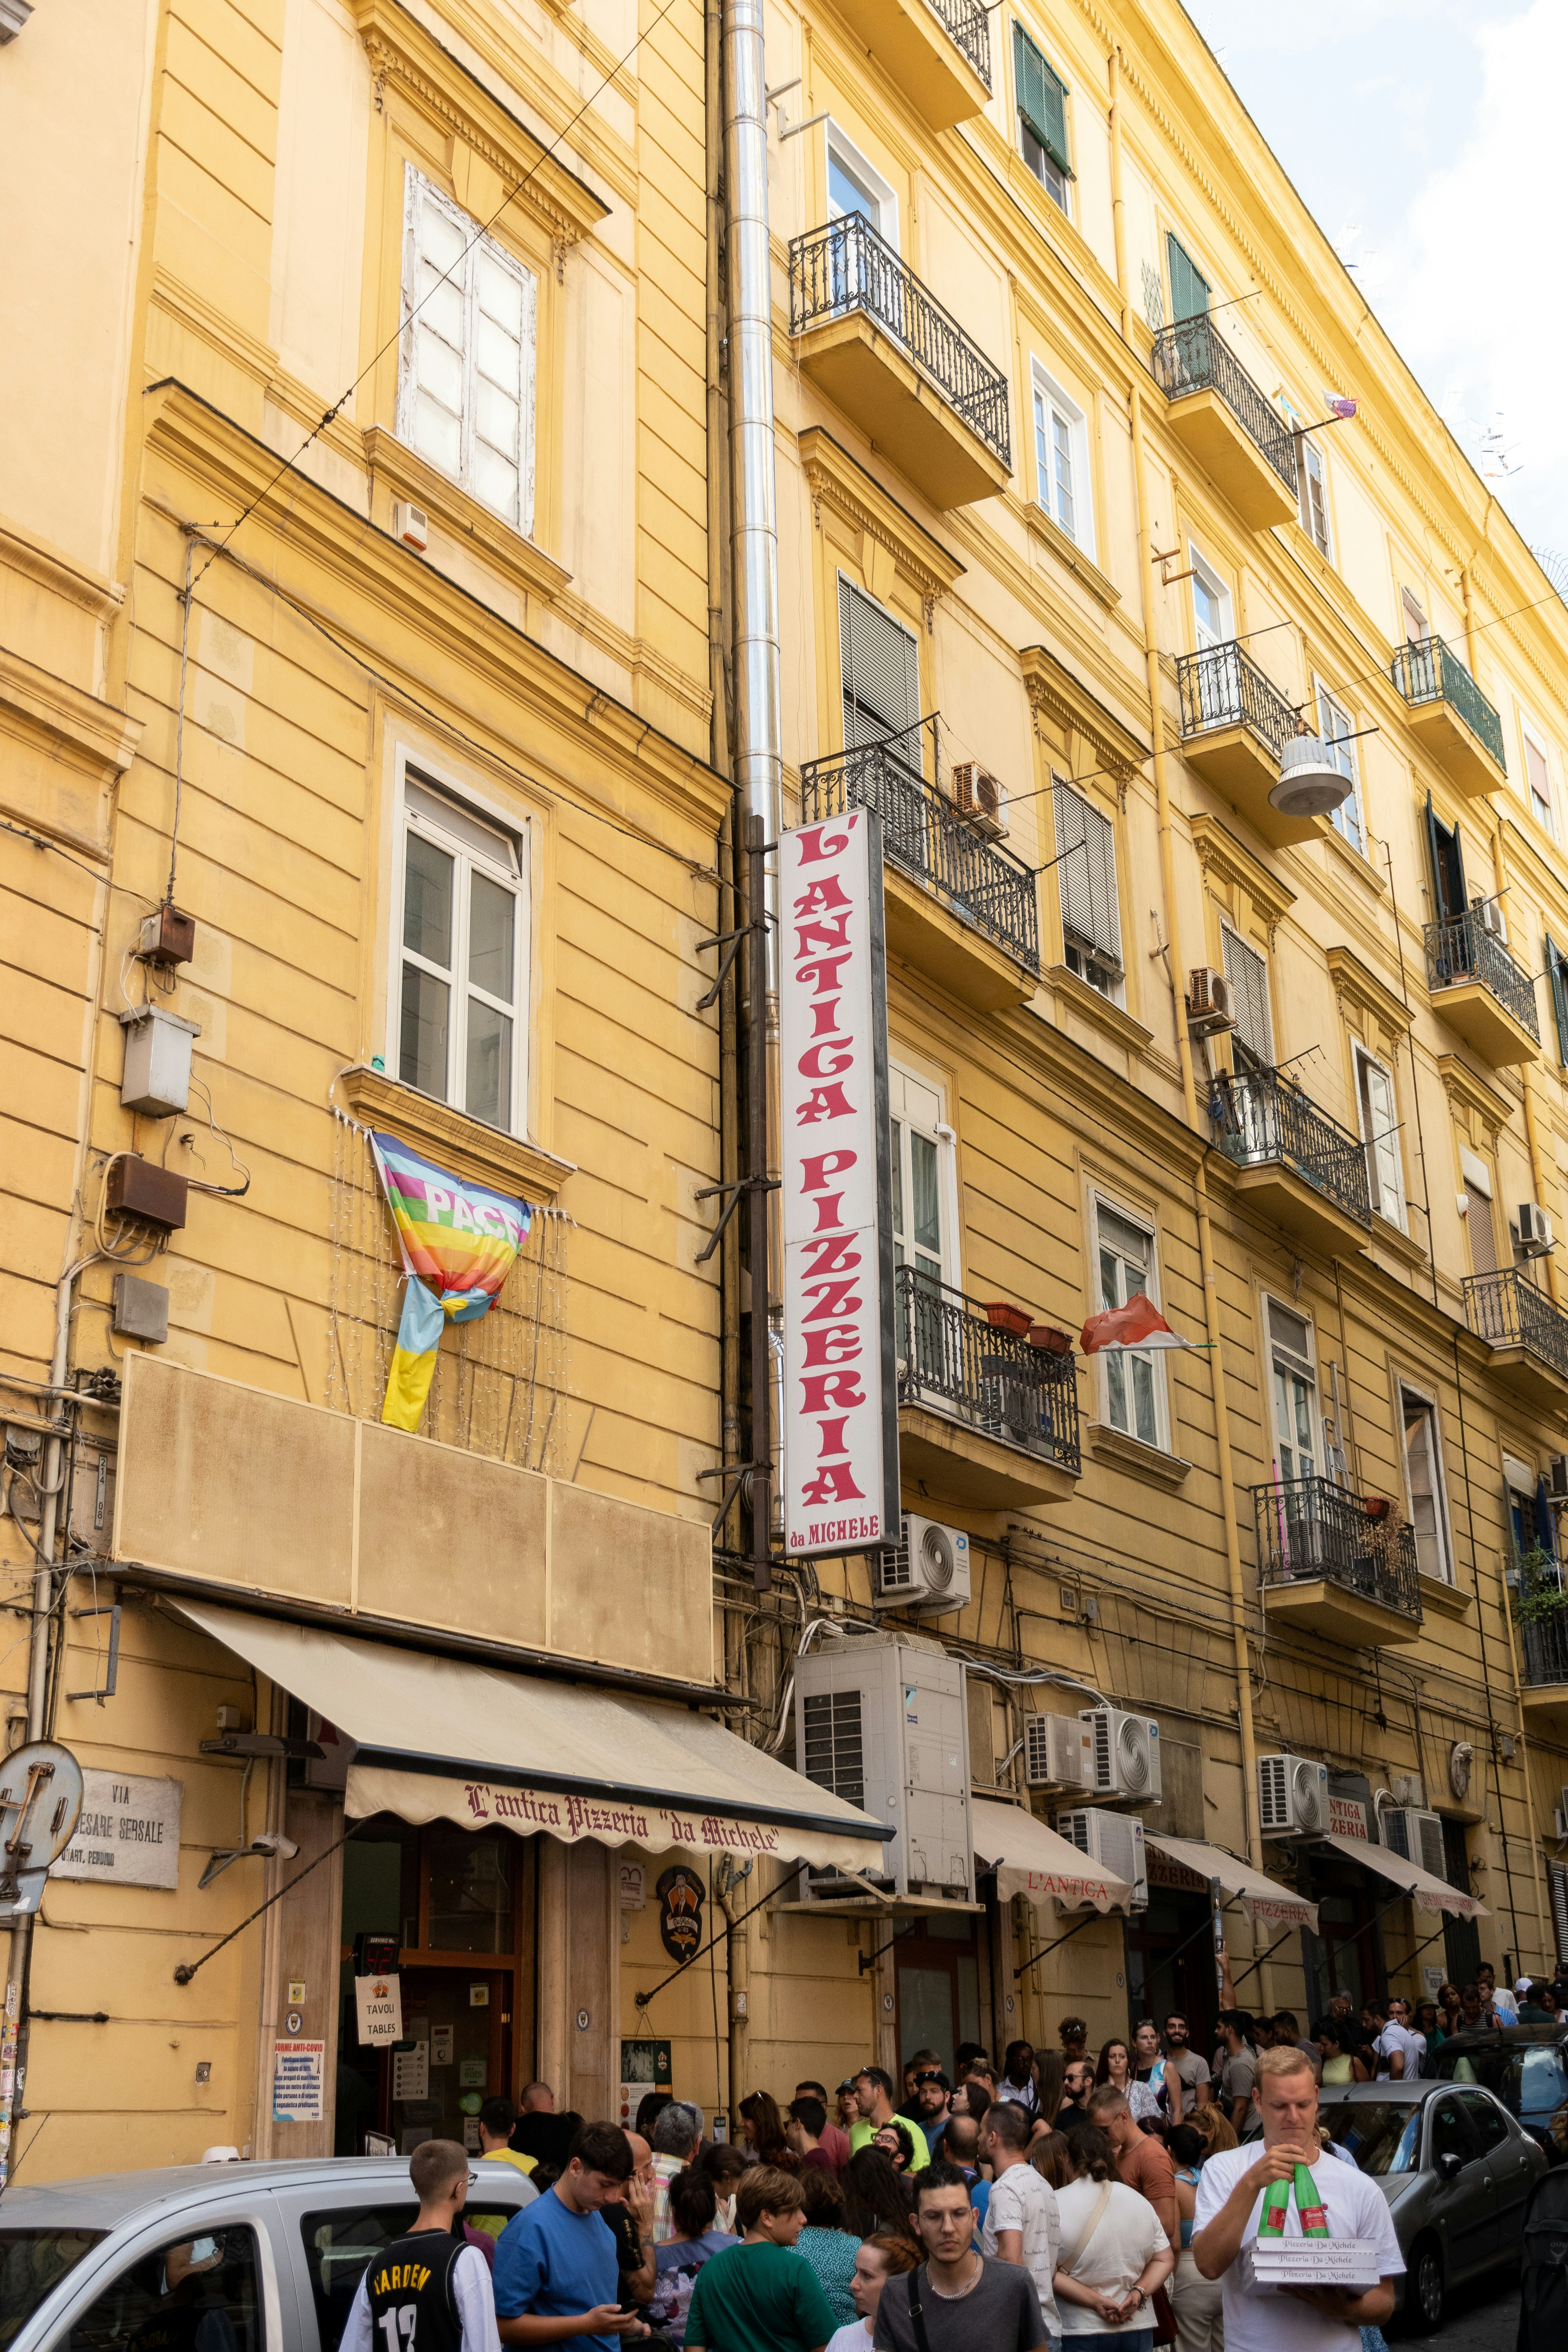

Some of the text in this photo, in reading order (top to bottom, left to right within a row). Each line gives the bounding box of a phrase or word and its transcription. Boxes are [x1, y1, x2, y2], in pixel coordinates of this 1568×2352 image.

[793, 814, 858, 1126] L'ANTICA
[423, 1180, 520, 1250] PACE
[799, 1149, 866, 1507] PIZZERIA
[98, 1502, 103, 1519] 08
[790, 1515, 879, 1548] da MICHELE
[112, 1785, 130, 1804] VIA
[465, 1784, 561, 1826] L'antica
[564, 1795, 649, 1838] Pizzeria
[119, 1817, 163, 1844] SERSALE
[88, 1850, 114, 1867] PENDINO
[1028, 1872, 1108, 1900] L'ANTICA
[1252, 1900, 1311, 1921] PIZZERIA
[367, 1947, 393, 1974] 42
[367, 2004, 394, 2014] TAVOLI
[368, 2023, 395, 2034] TABLES
[293, 2043, 323, 2052] ANTI-COVID
[1282, 2240, 1356, 2250] Pizzeria Da Michele
[1278, 2255, 1352, 2265] Pizzeria Da Michele
[1281, 2270, 1355, 2280] Pizzeria Da Michele
